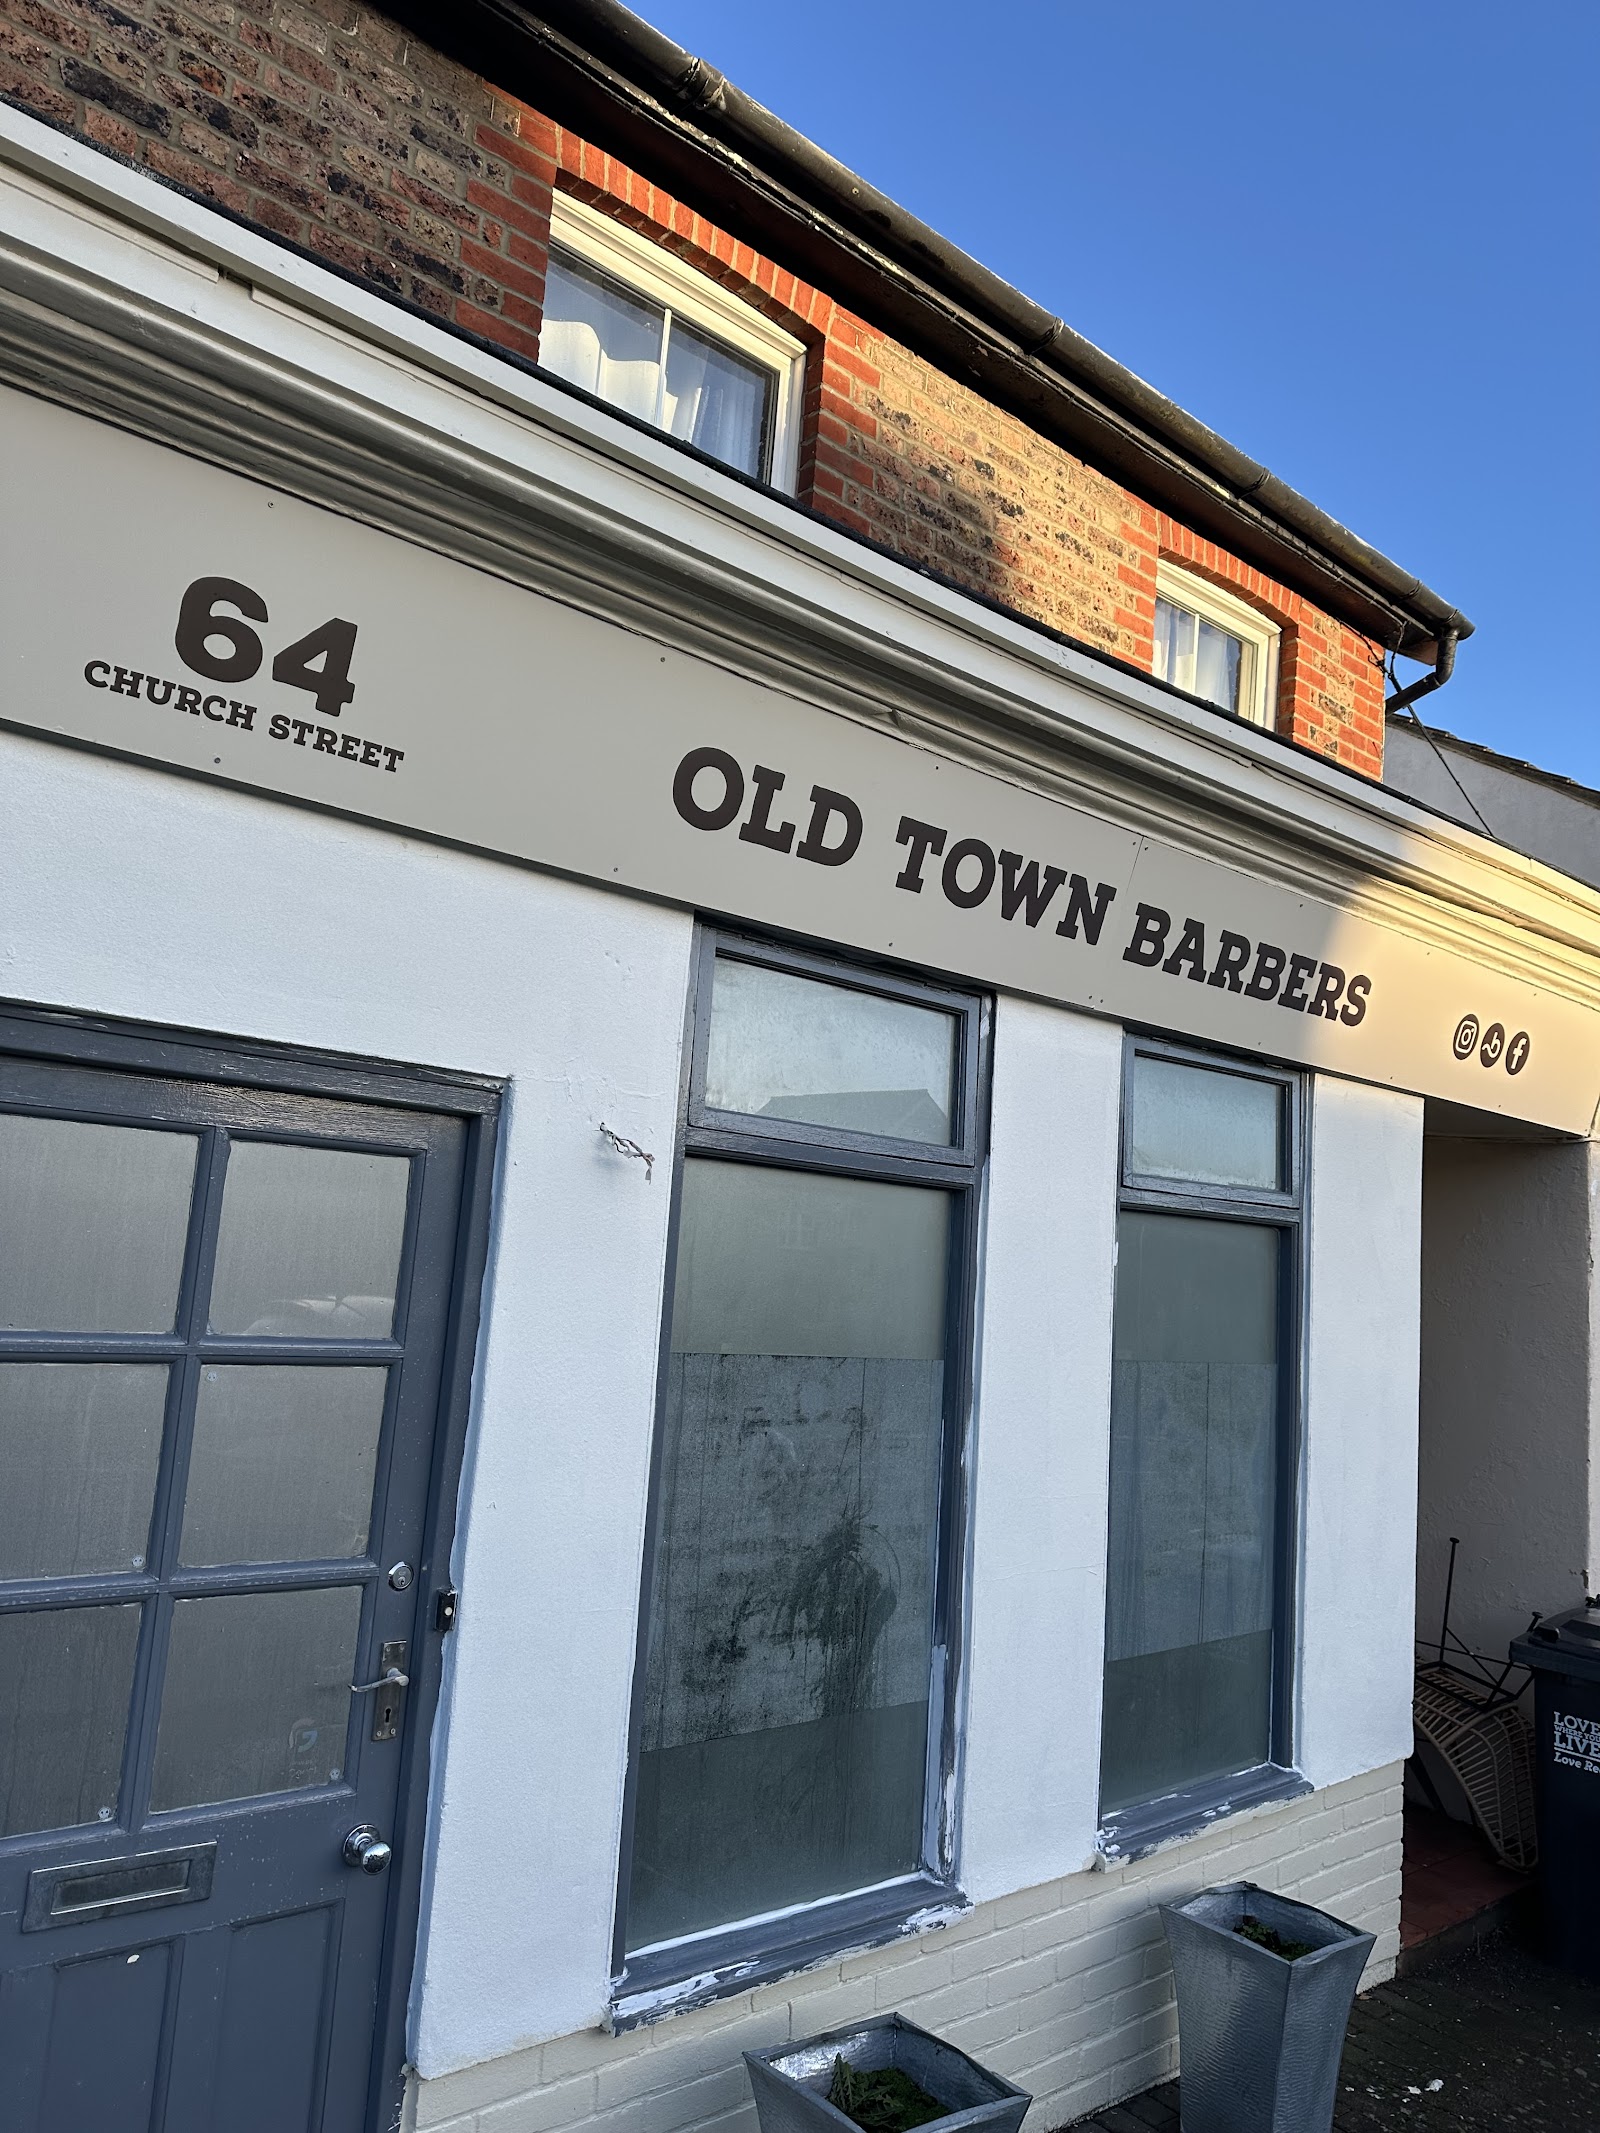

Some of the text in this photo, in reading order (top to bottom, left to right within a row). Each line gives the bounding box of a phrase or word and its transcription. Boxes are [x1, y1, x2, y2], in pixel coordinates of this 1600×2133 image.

[174, 576, 358, 718] 64
[84, 660, 405, 773] CHURCH STREET
[672, 746, 1372, 1028] OLD TOWN BARBERS
[1553, 1751, 1582, 1769] Love
[1554, 1724, 1583, 1738] WHERE
